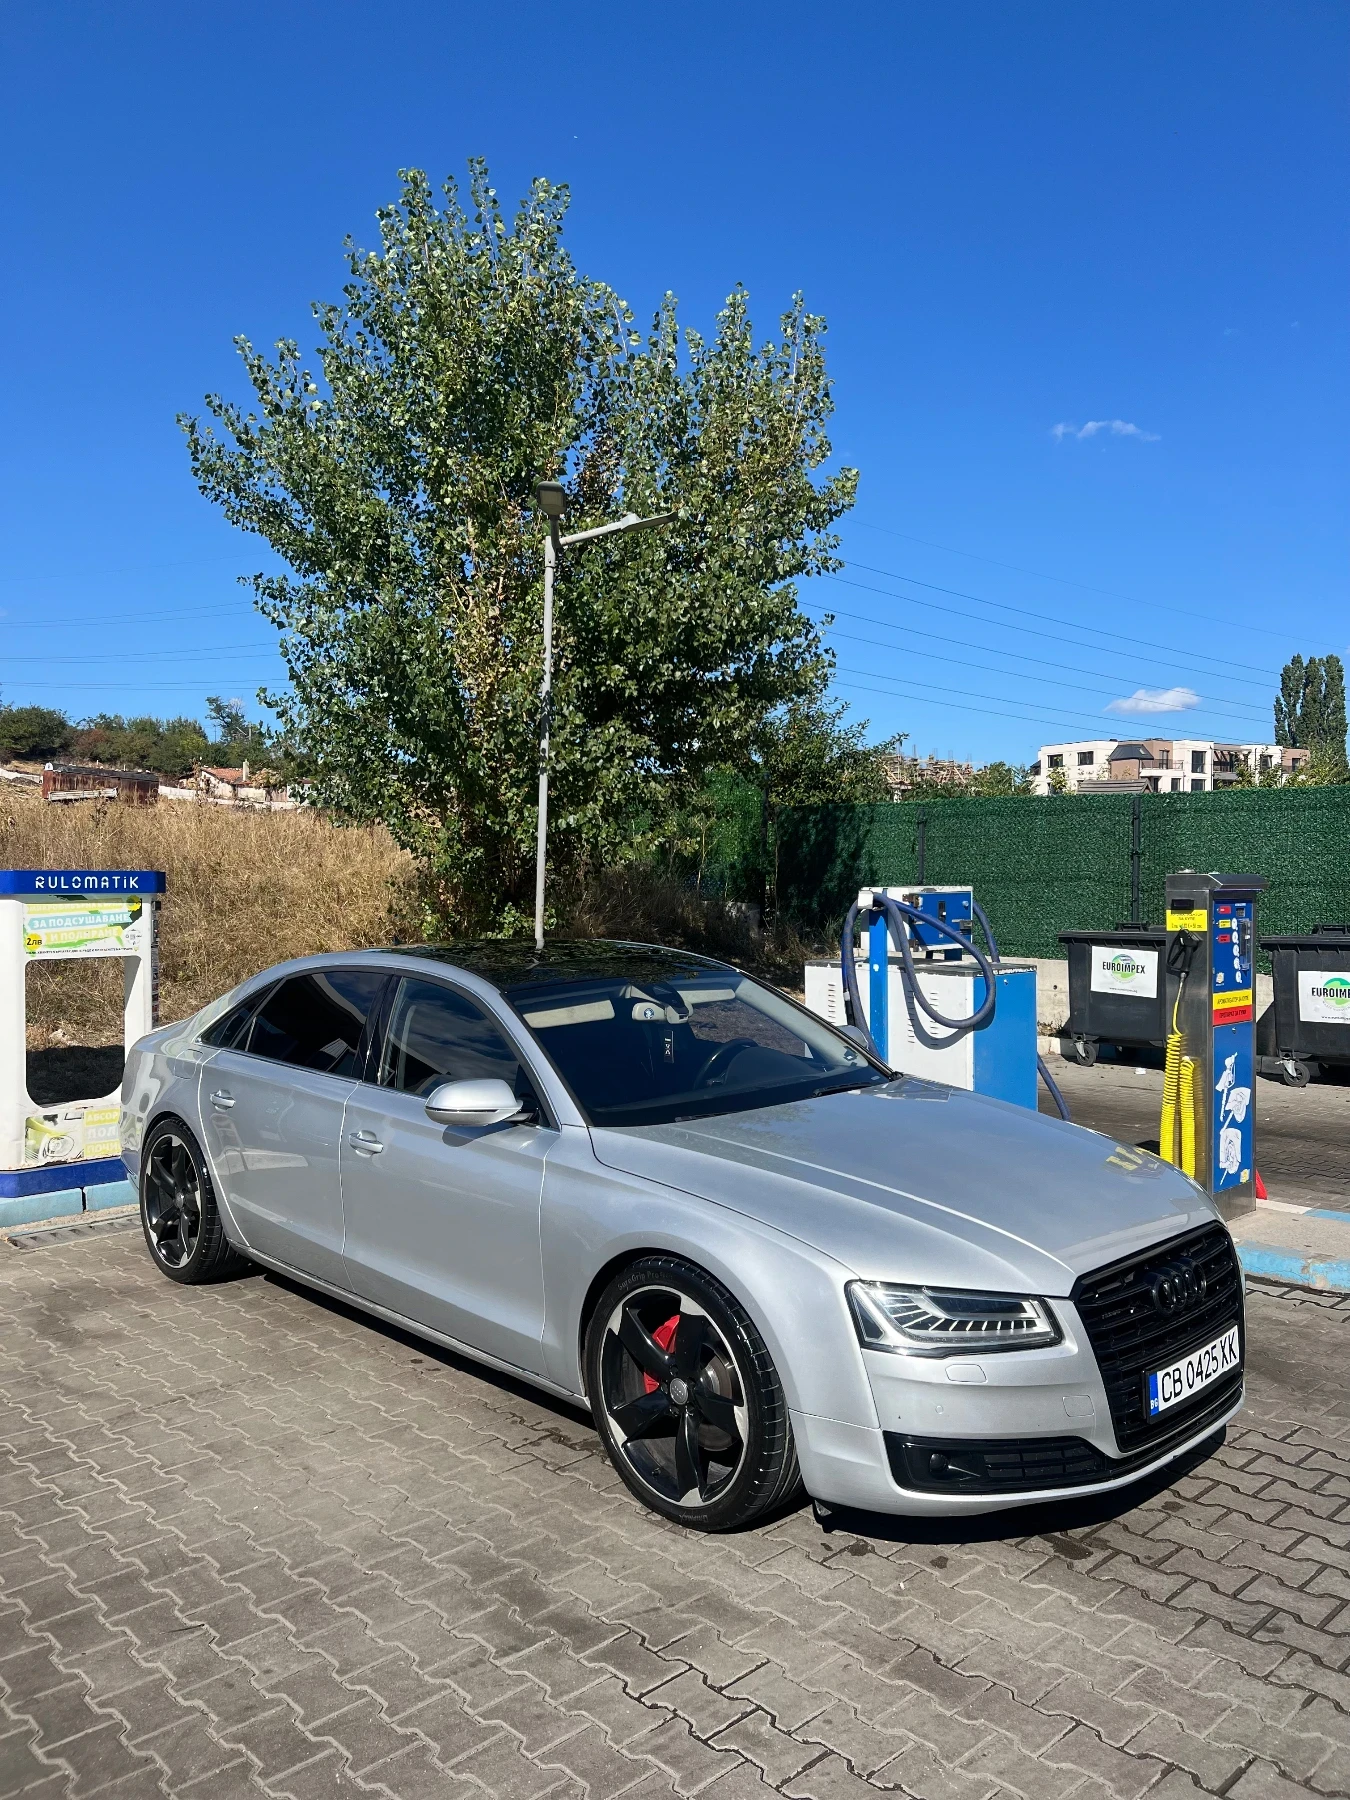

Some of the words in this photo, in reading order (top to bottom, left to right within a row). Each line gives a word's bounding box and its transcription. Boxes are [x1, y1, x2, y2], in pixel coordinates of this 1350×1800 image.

[33, 919, 47, 928] ЗА
[49, 913, 129, 927] ПОДСУШАВАНЕ
[50, 933, 58, 942] И
[61, 928, 118, 941] ПОЛИРАНЕ
[1102, 961, 1146, 974] EUROIMPEX
[1162, 1367, 1183, 1403] CB
[1186, 1343, 1218, 1389] 0425
[1219, 1331, 1237, 1369] XK
[1150, 1397, 1158, 1410] BG
